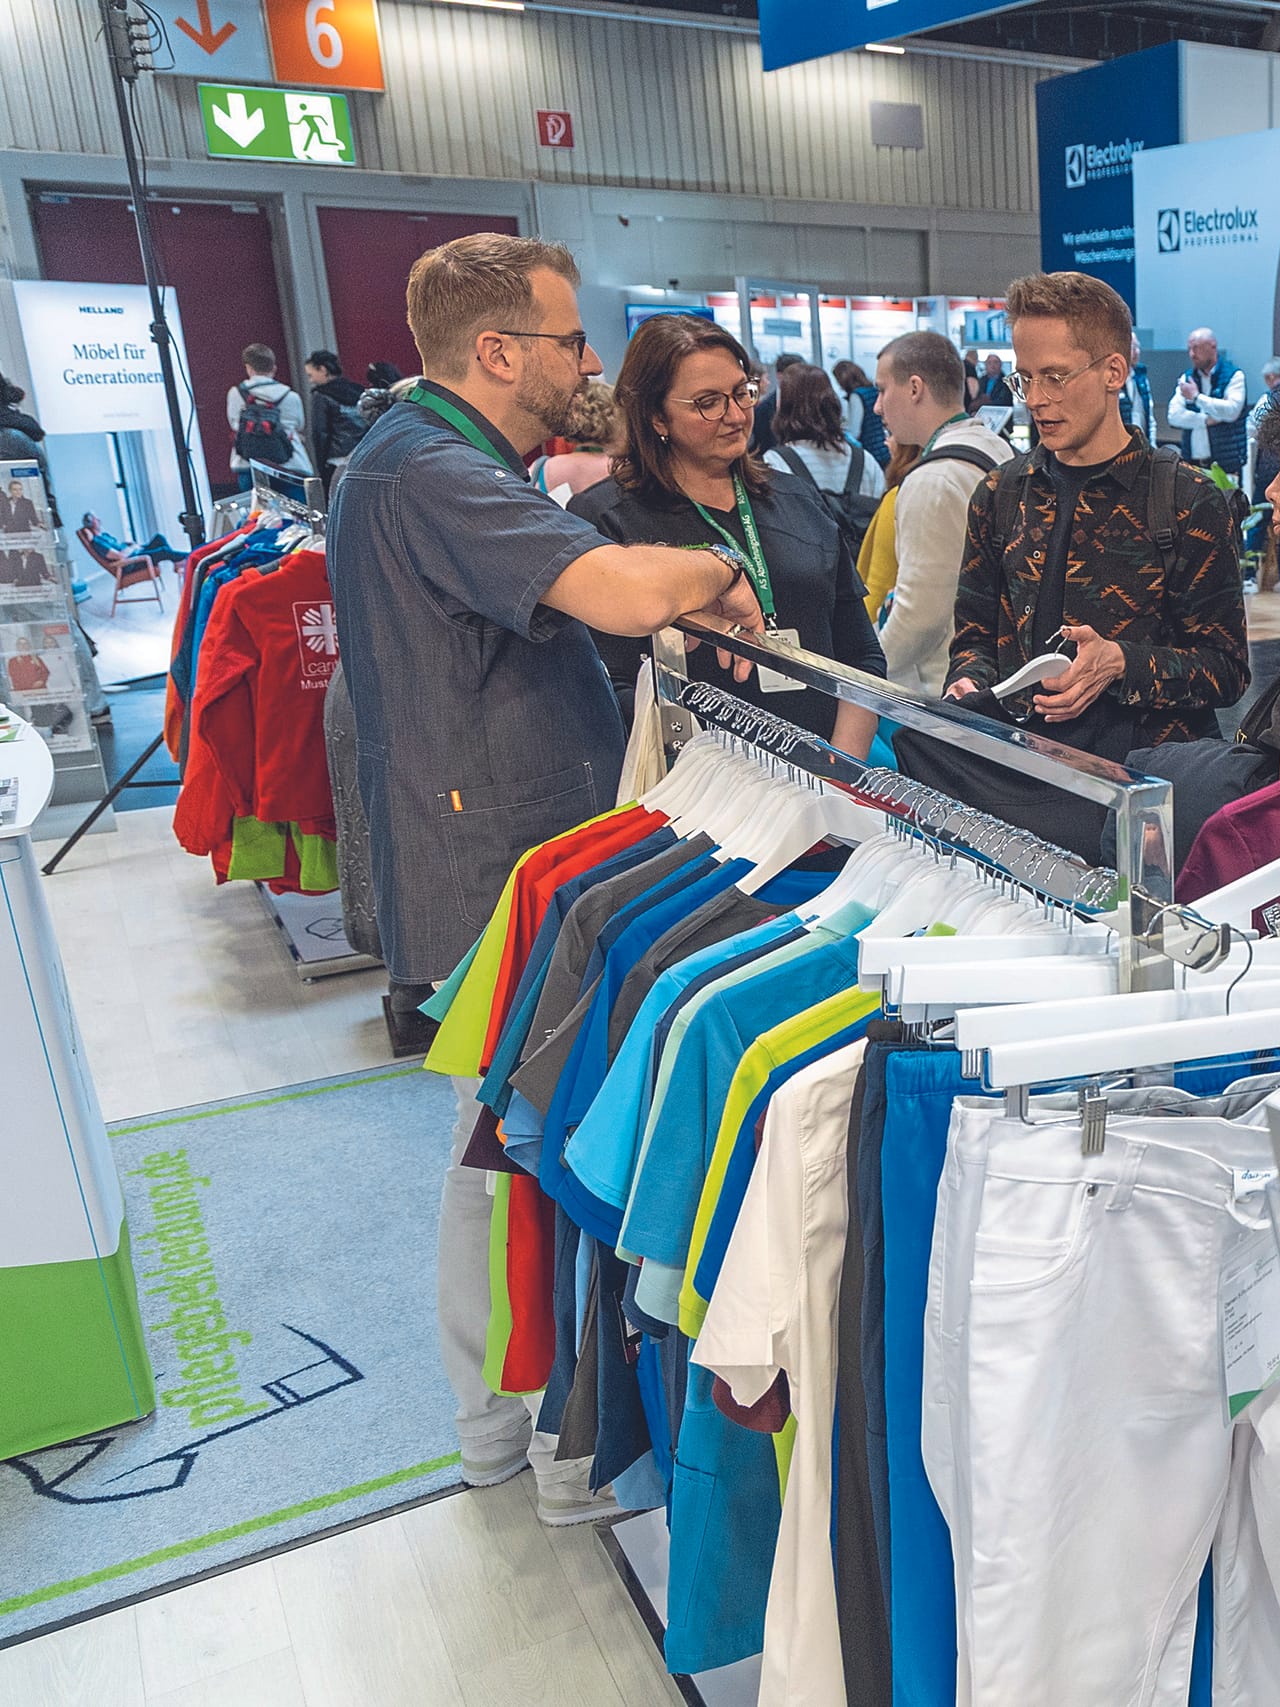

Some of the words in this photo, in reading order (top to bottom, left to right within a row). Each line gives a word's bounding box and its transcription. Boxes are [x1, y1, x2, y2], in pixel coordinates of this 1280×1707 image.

[306, 0, 342, 69] 6
[1184, 205, 1258, 233] Electrolux
[1184, 234, 1258, 246] PROFESSIONAL
[79, 306, 124, 314] HELLAND
[73, 343, 120, 360] Möbel
[123, 343, 146, 360] für
[63, 368, 164, 386] Generationen
[126, 1148, 269, 1430] pflegebekleidung.de
